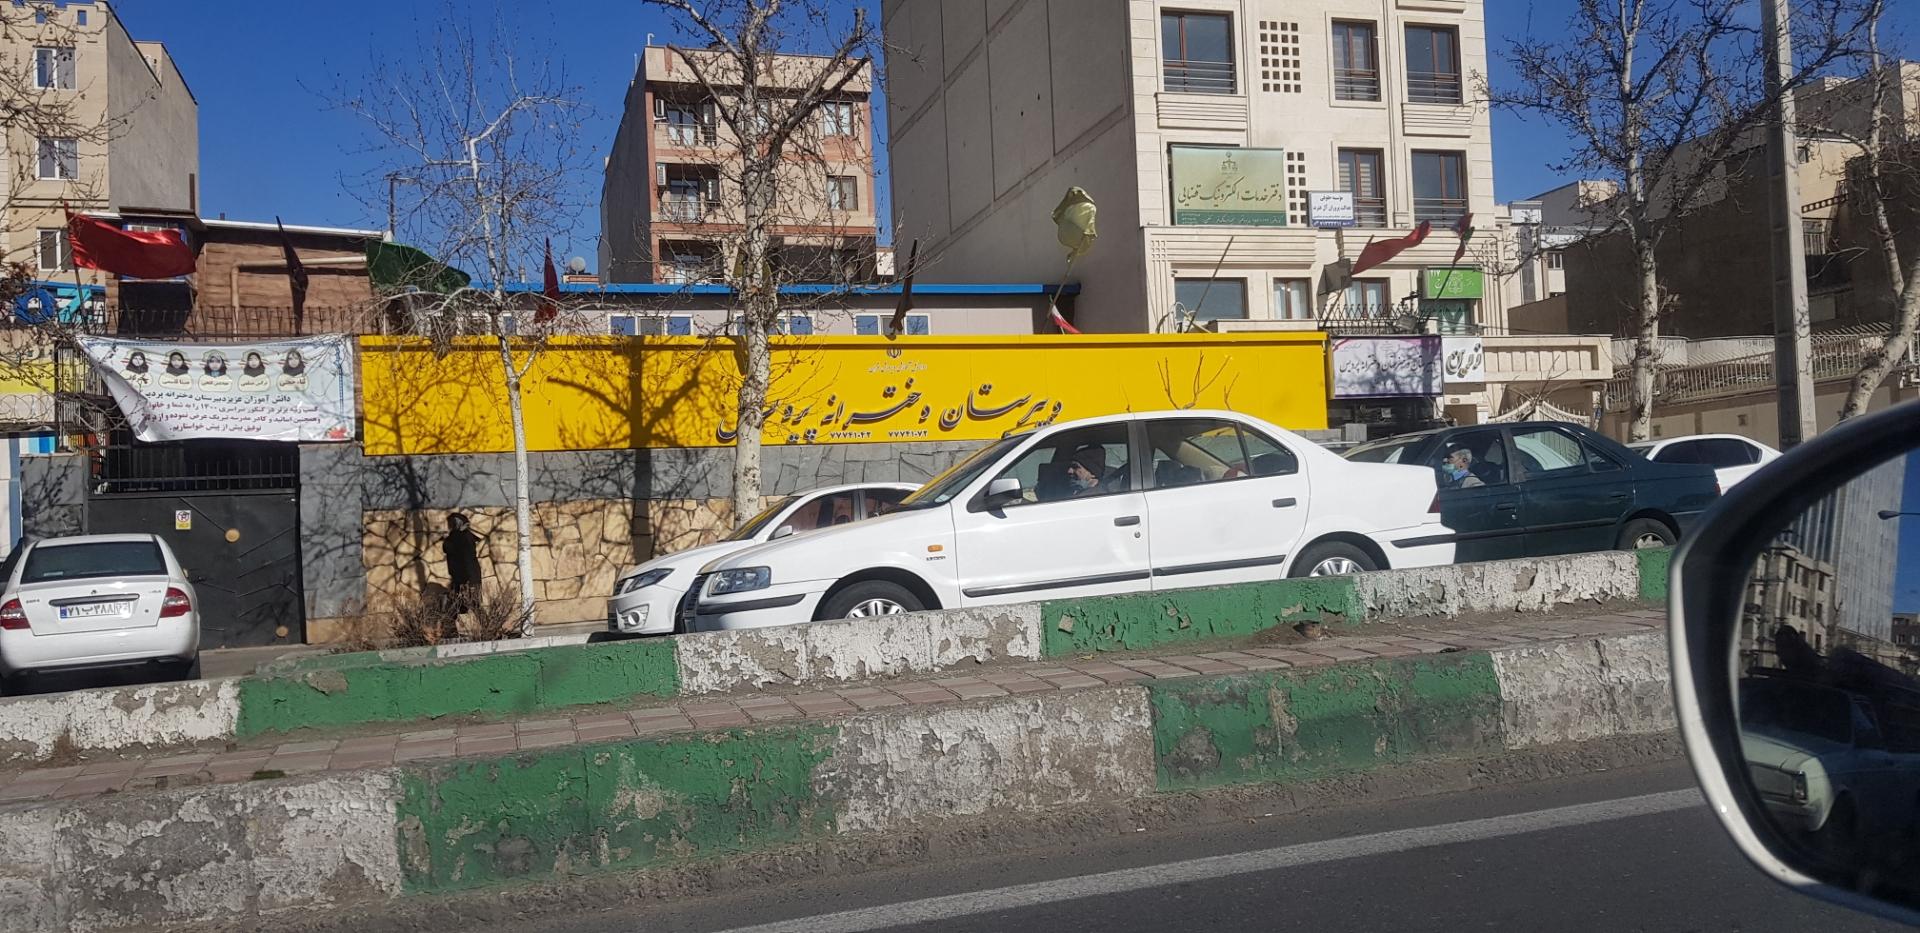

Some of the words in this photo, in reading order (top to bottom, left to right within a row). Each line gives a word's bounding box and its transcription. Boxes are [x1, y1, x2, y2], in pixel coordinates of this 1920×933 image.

[1199, 175, 1246, 208] الکترونیک
[1241, 187, 1268, 203] خدمات
[1266, 183, 1282, 204] دفتر
[1339, 360, 1360, 374] پردیس
[1361, 353, 1381, 374] دخترانه
[165, 391, 193, 400] دخترانه
[194, 393, 227, 403] دبیرستان
[226, 395, 243, 404] عزیز
[243, 393, 270, 404] آموزان
[272, 393, 291, 404] دانش
[171, 400, 184, 408] شما
[218, 404, 246, 413] سراسری
[302, 405, 319, 413] کسب
[820, 377, 932, 431] دخترانه
[938, 383, 1063, 430] دبیرستان
[247, 405, 266, 415] کنکور
[169, 411, 188, 420] نموده
[189, 413, 207, 422] عرض
[208, 412, 229, 422] تبریک
[230, 414, 252, 422] مدرسه
[253, 415, 267, 423] کادر
[244, 424, 262, 432] توفیق
